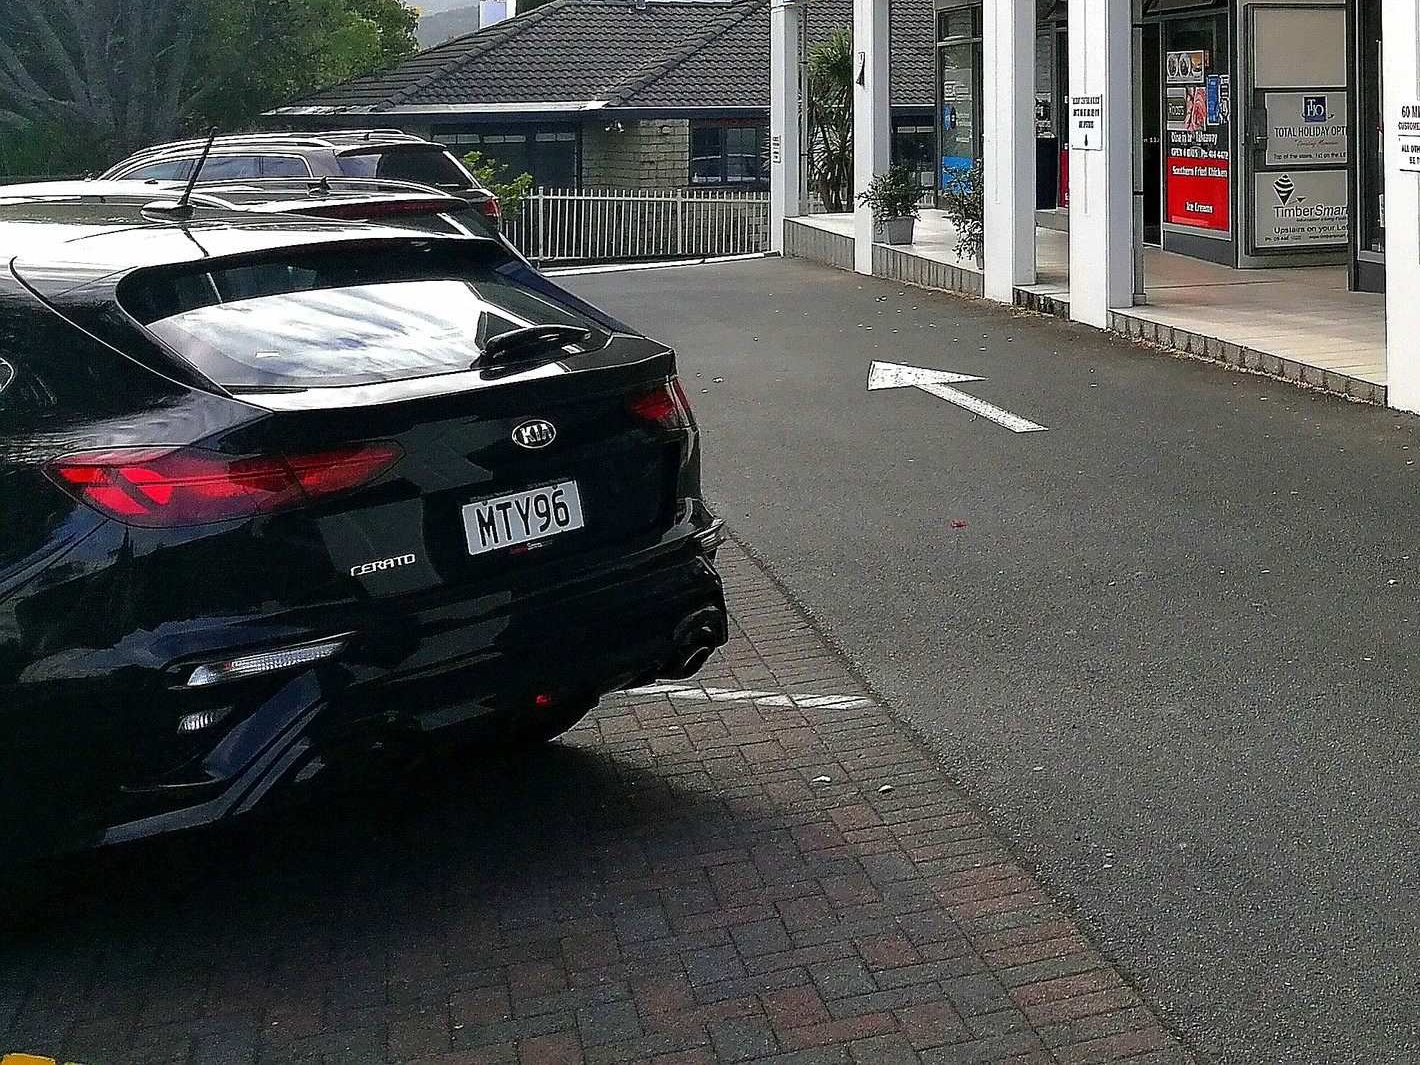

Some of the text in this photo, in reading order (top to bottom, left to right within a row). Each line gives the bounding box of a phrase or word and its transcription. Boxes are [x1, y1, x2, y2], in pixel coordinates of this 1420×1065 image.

[1401, 105, 1411, 118] 60
[1274, 127, 1297, 137] TOTAL
[1299, 126, 1330, 137] HOLIDAY
[1401, 144, 1410, 153] ALL
[1409, 156, 1416, 165] BE
[1172, 165, 1228, 177] Southern Fried Chicken
[1273, 204, 1348, 217] TimberSmar
[1274, 226, 1305, 235] Upstairs
[1318, 224, 1335, 234] your
[519, 422, 553, 445] KIA
[474, 488, 571, 548] MTY96
[350, 553, 416, 577] CERATO
